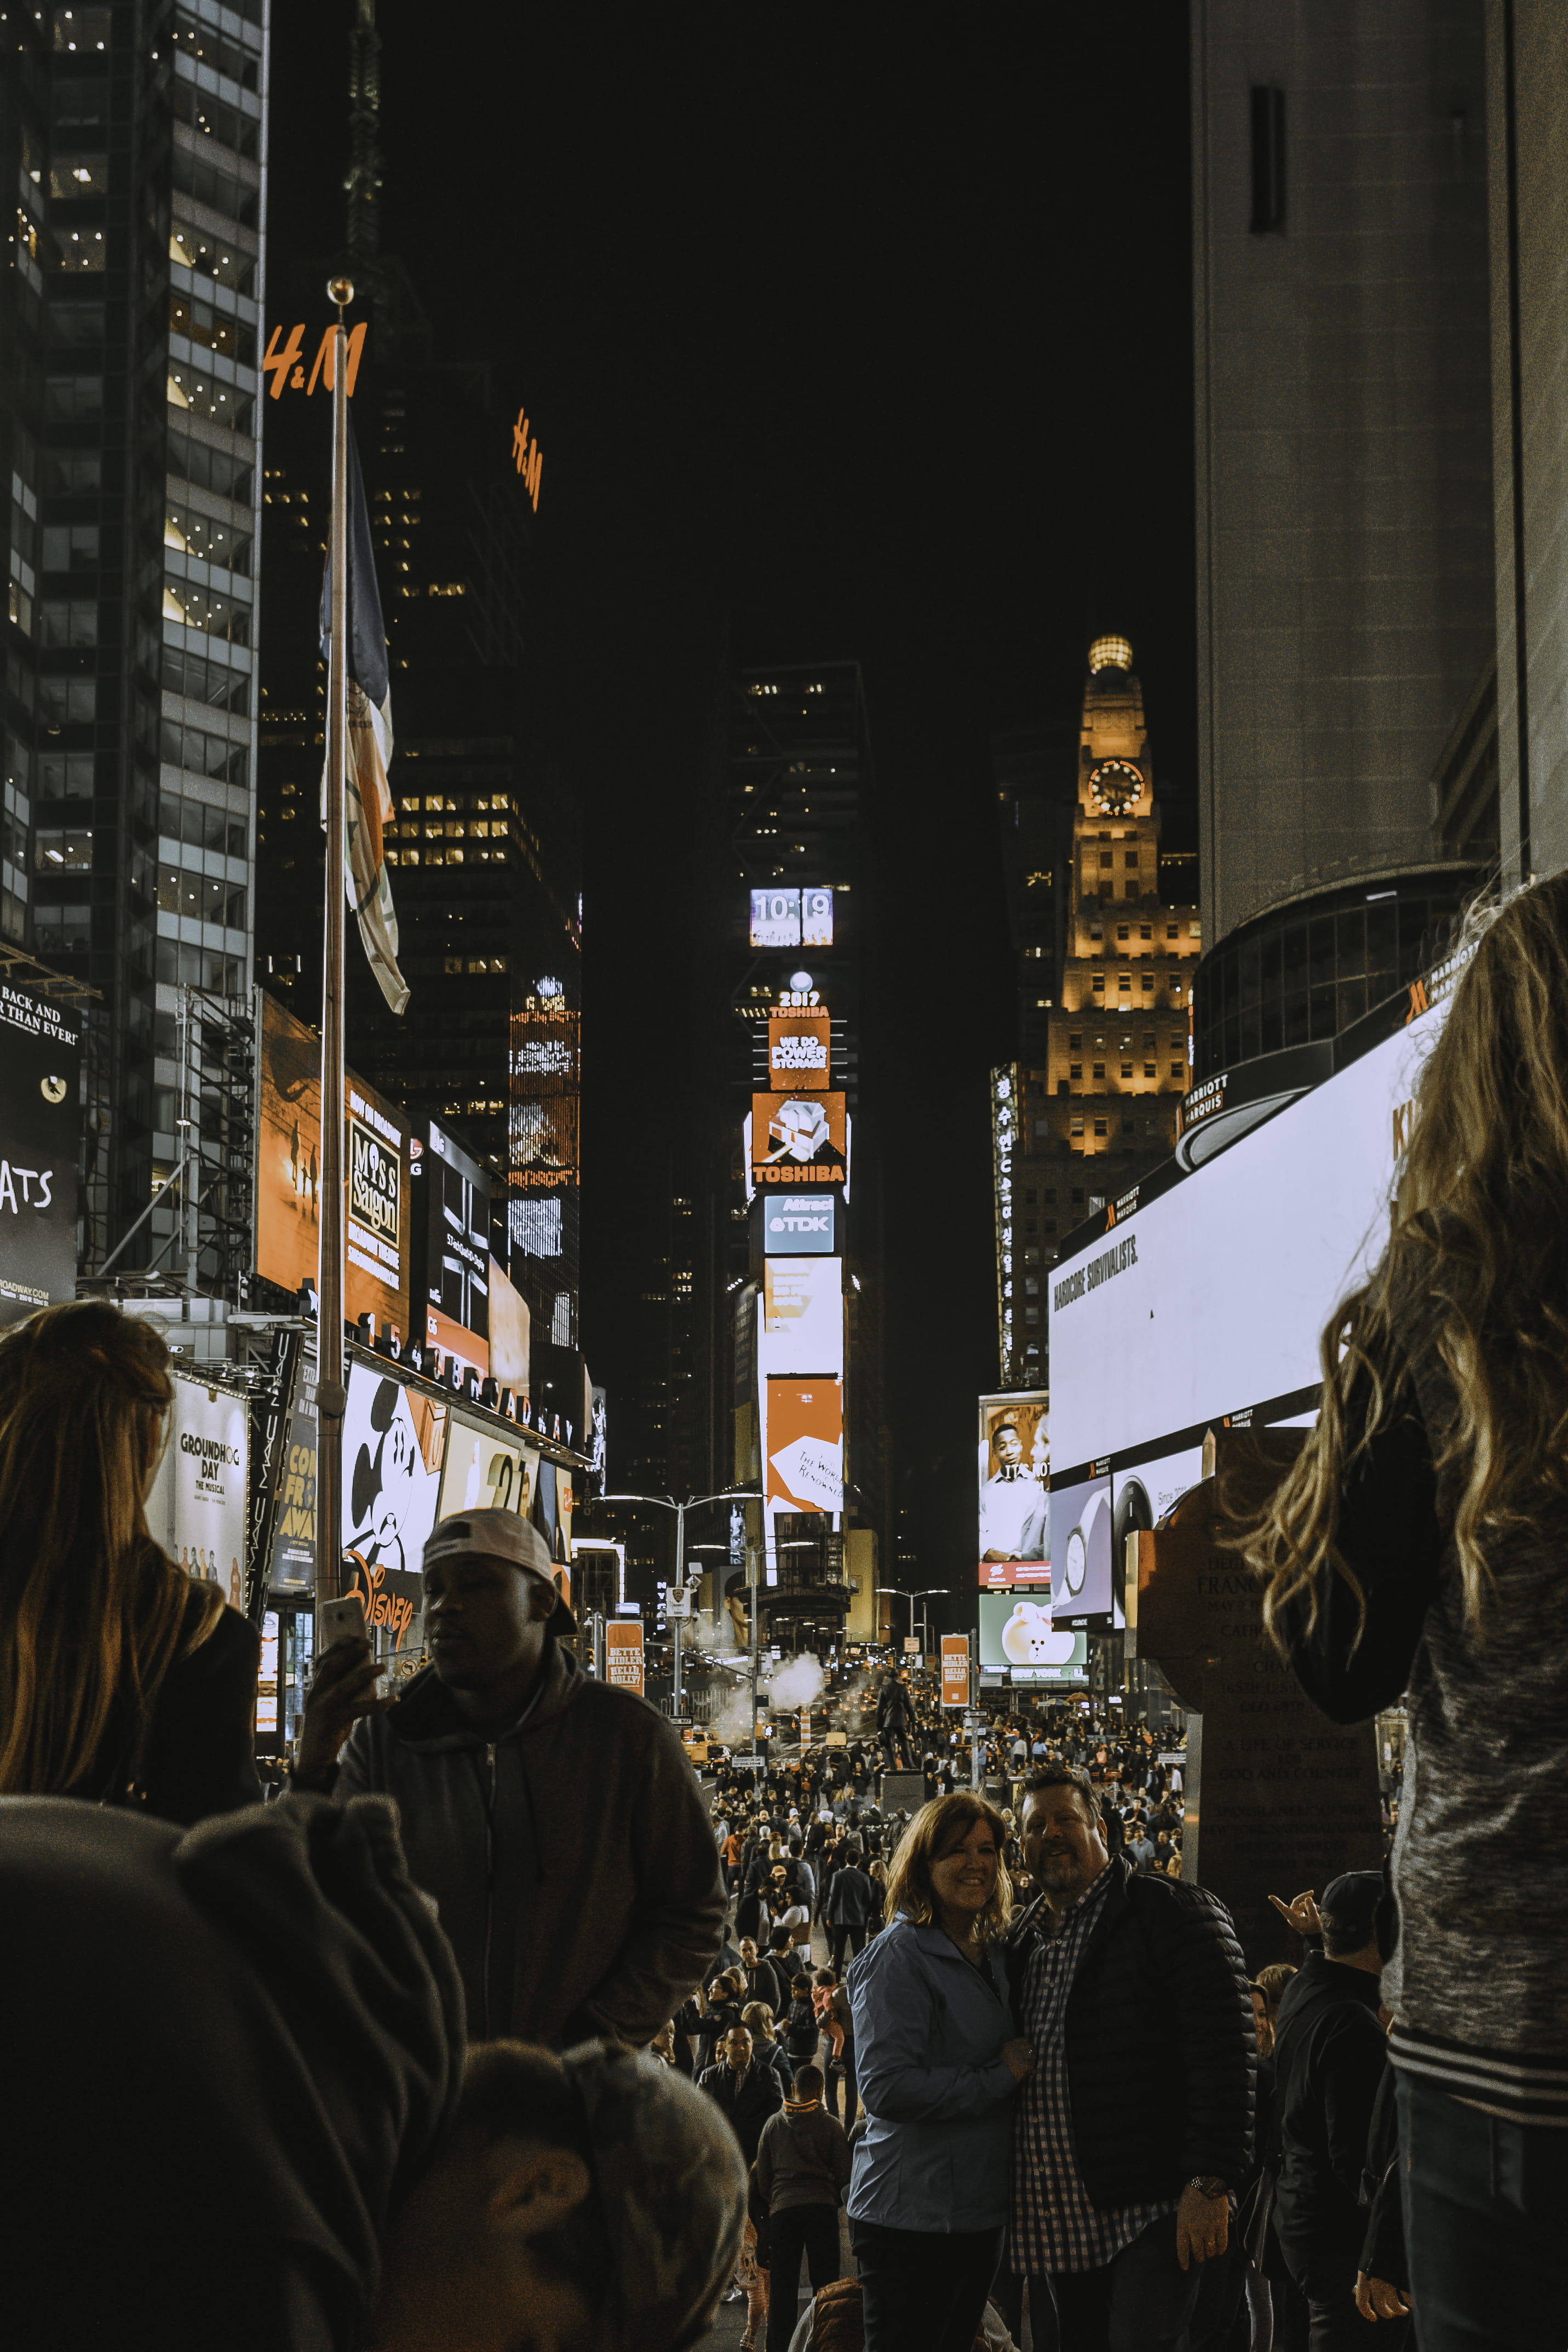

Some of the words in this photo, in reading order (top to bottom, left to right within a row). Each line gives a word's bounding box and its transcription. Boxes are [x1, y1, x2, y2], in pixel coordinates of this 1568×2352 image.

[263, 322, 367, 400] H&M
[755, 895, 829, 920] 10:19
[2, 985, 33, 1011] BACK
[36, 1003, 61, 1023] AND
[779, 991, 820, 1007] 2017
[7, 1003, 41, 1030] THAN
[769, 1006, 829, 1018] TOSHIBA
[771, 1046, 827, 1059] POWER
[780, 1036, 799, 1048] WE
[801, 1036, 819, 1047] DO
[771, 1058, 826, 1069] STORAGE
[1185, 1074, 1229, 1109] MARRIOTT
[1185, 1094, 1222, 1126] MARQUIS
[753, 1166, 845, 1183] TOSHIBA
[0, 1160, 53, 1214] ATS
[353, 1169, 397, 1234] Saigon
[782, 1217, 829, 1232] TDK
[1054, 1267, 1086, 1312] HARDCORE
[1087, 1234, 1138, 1292] SURVIVALISTS.
[0, 1278, 49, 1300] ROADWAY.COM
[181, 1433, 239, 1466] GROUNDHOG
[202, 1459, 220, 1481] DAY
[289, 1444, 317, 1478] COM
[1033, 1462, 1051, 1477] NO
[196, 1480, 204, 1490] THE
[205, 1482, 225, 1495] MUSICAL
[607, 1656, 642, 1665] MIDLER
[610, 1647, 641, 1656] BETTE
